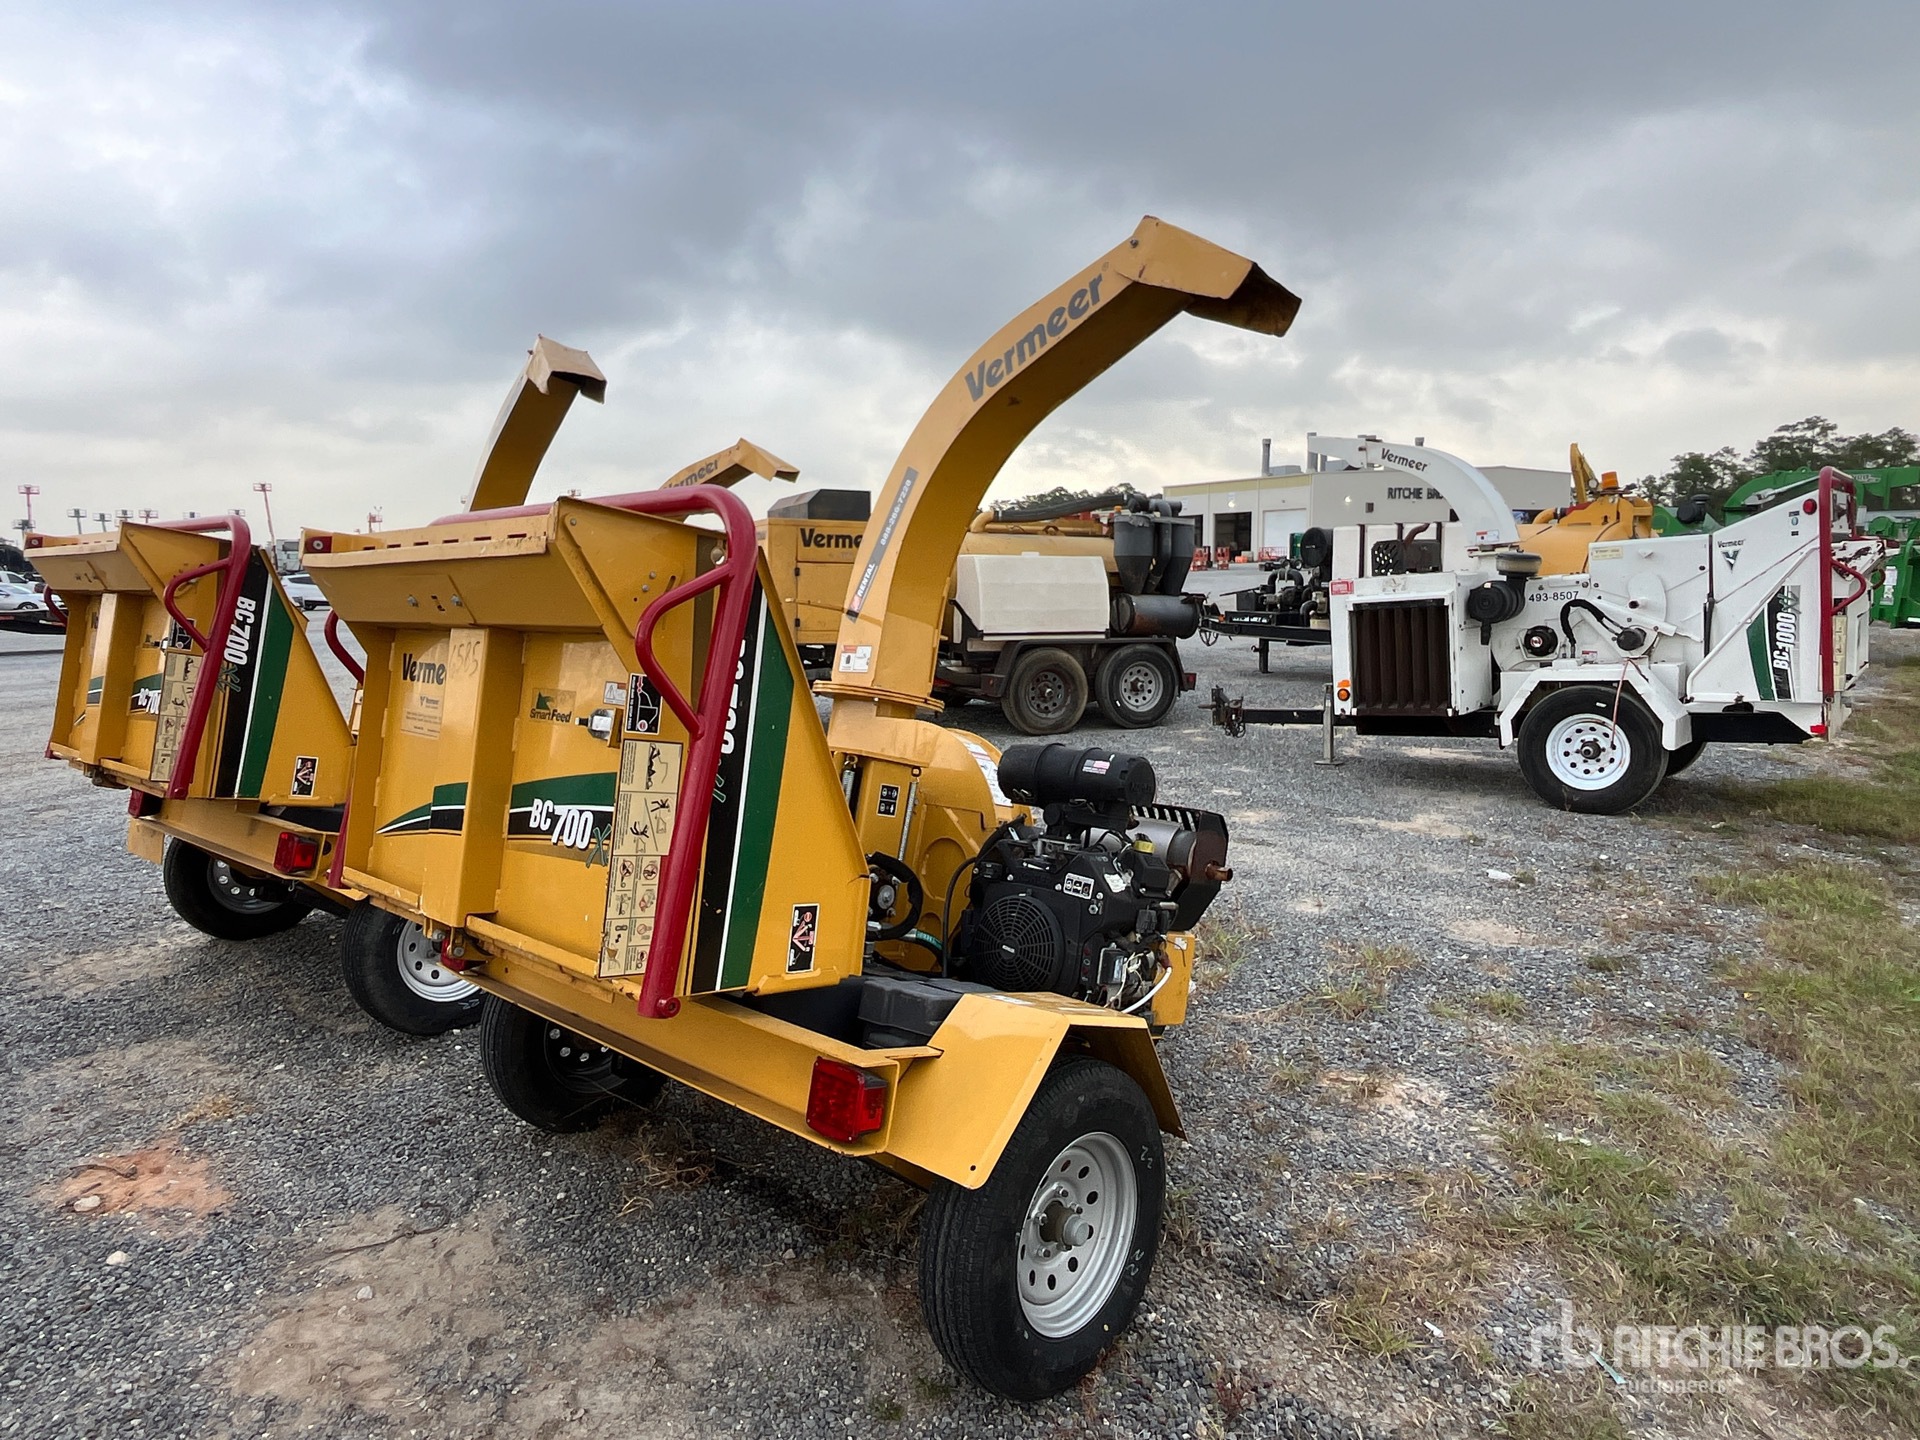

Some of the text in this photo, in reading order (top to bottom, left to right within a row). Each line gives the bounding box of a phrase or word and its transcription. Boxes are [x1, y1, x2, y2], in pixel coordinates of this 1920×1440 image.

[964, 272, 1103, 402] Vermeer
[662, 459, 718, 488] rmeer
[1381, 448, 1428, 472] Vermeer
[1387, 487, 1423, 499] RITCHIE
[857, 563, 876, 597] RENTAL
[1528, 591, 1579, 602] 493-8507
[402, 653, 447, 685] Verme
